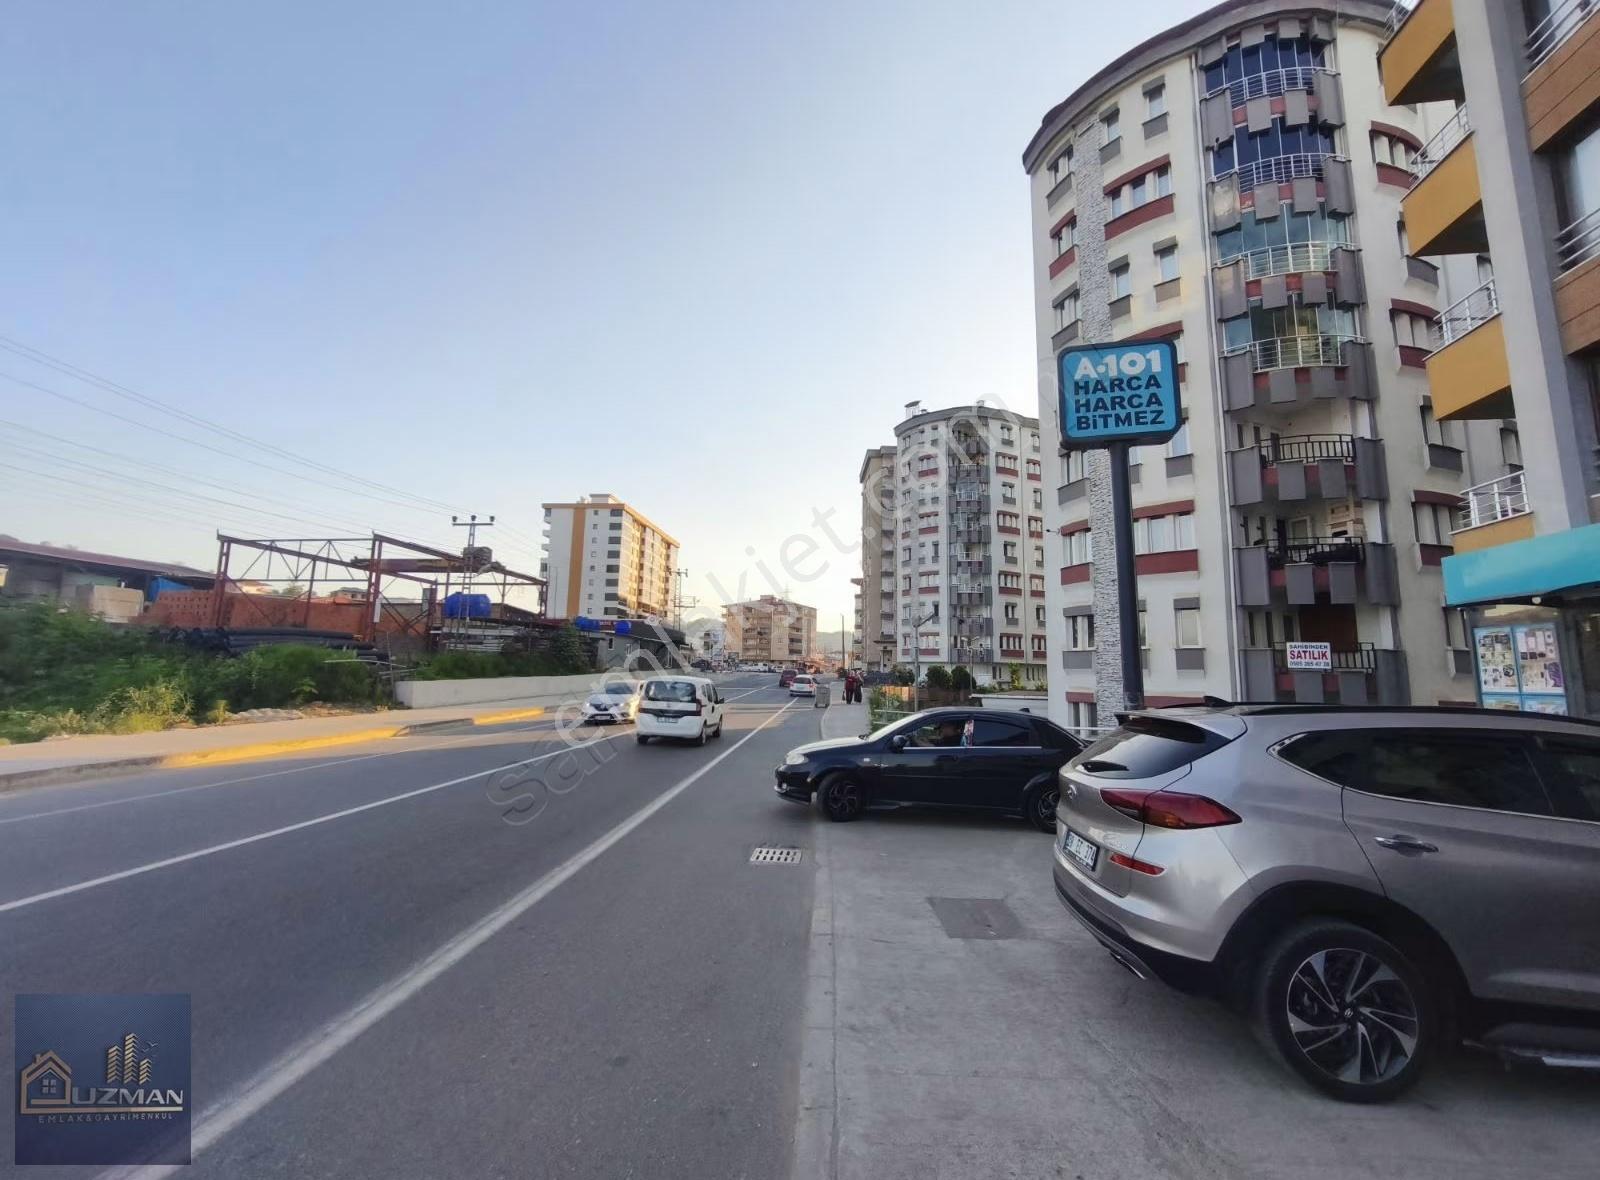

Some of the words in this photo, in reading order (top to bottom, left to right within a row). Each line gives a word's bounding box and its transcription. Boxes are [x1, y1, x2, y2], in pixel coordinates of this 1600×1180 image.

[1074, 374, 1162, 395] HARCA
[1075, 392, 1163, 413] HARCA
[1290, 650, 1328, 660] SATILIK
